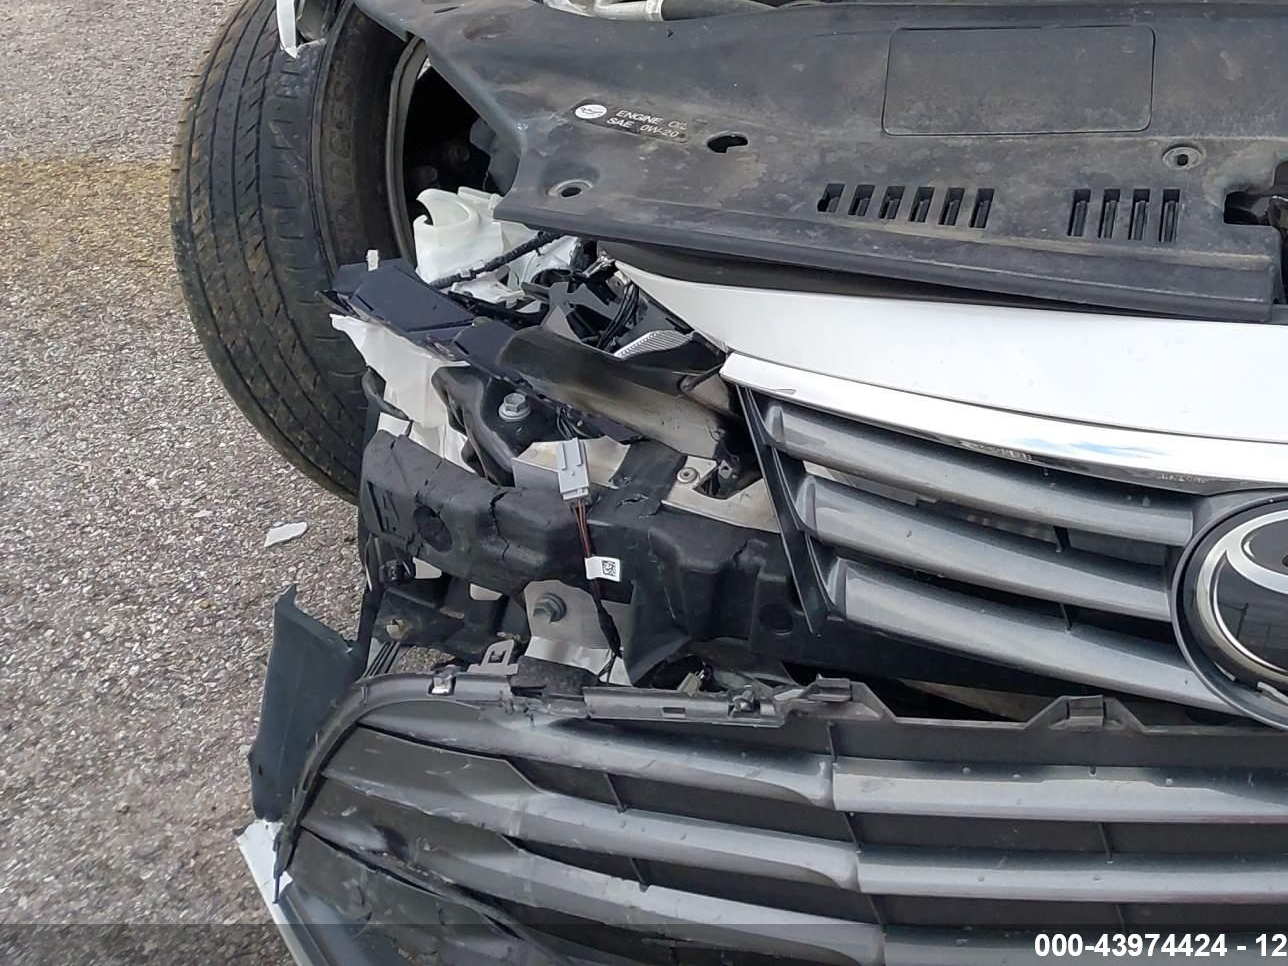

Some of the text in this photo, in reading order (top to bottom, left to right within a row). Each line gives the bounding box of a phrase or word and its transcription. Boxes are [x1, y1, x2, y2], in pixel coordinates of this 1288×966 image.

[615, 109, 664, 125] ENGINE
[606, 117, 680, 138] SAE 0W-20
